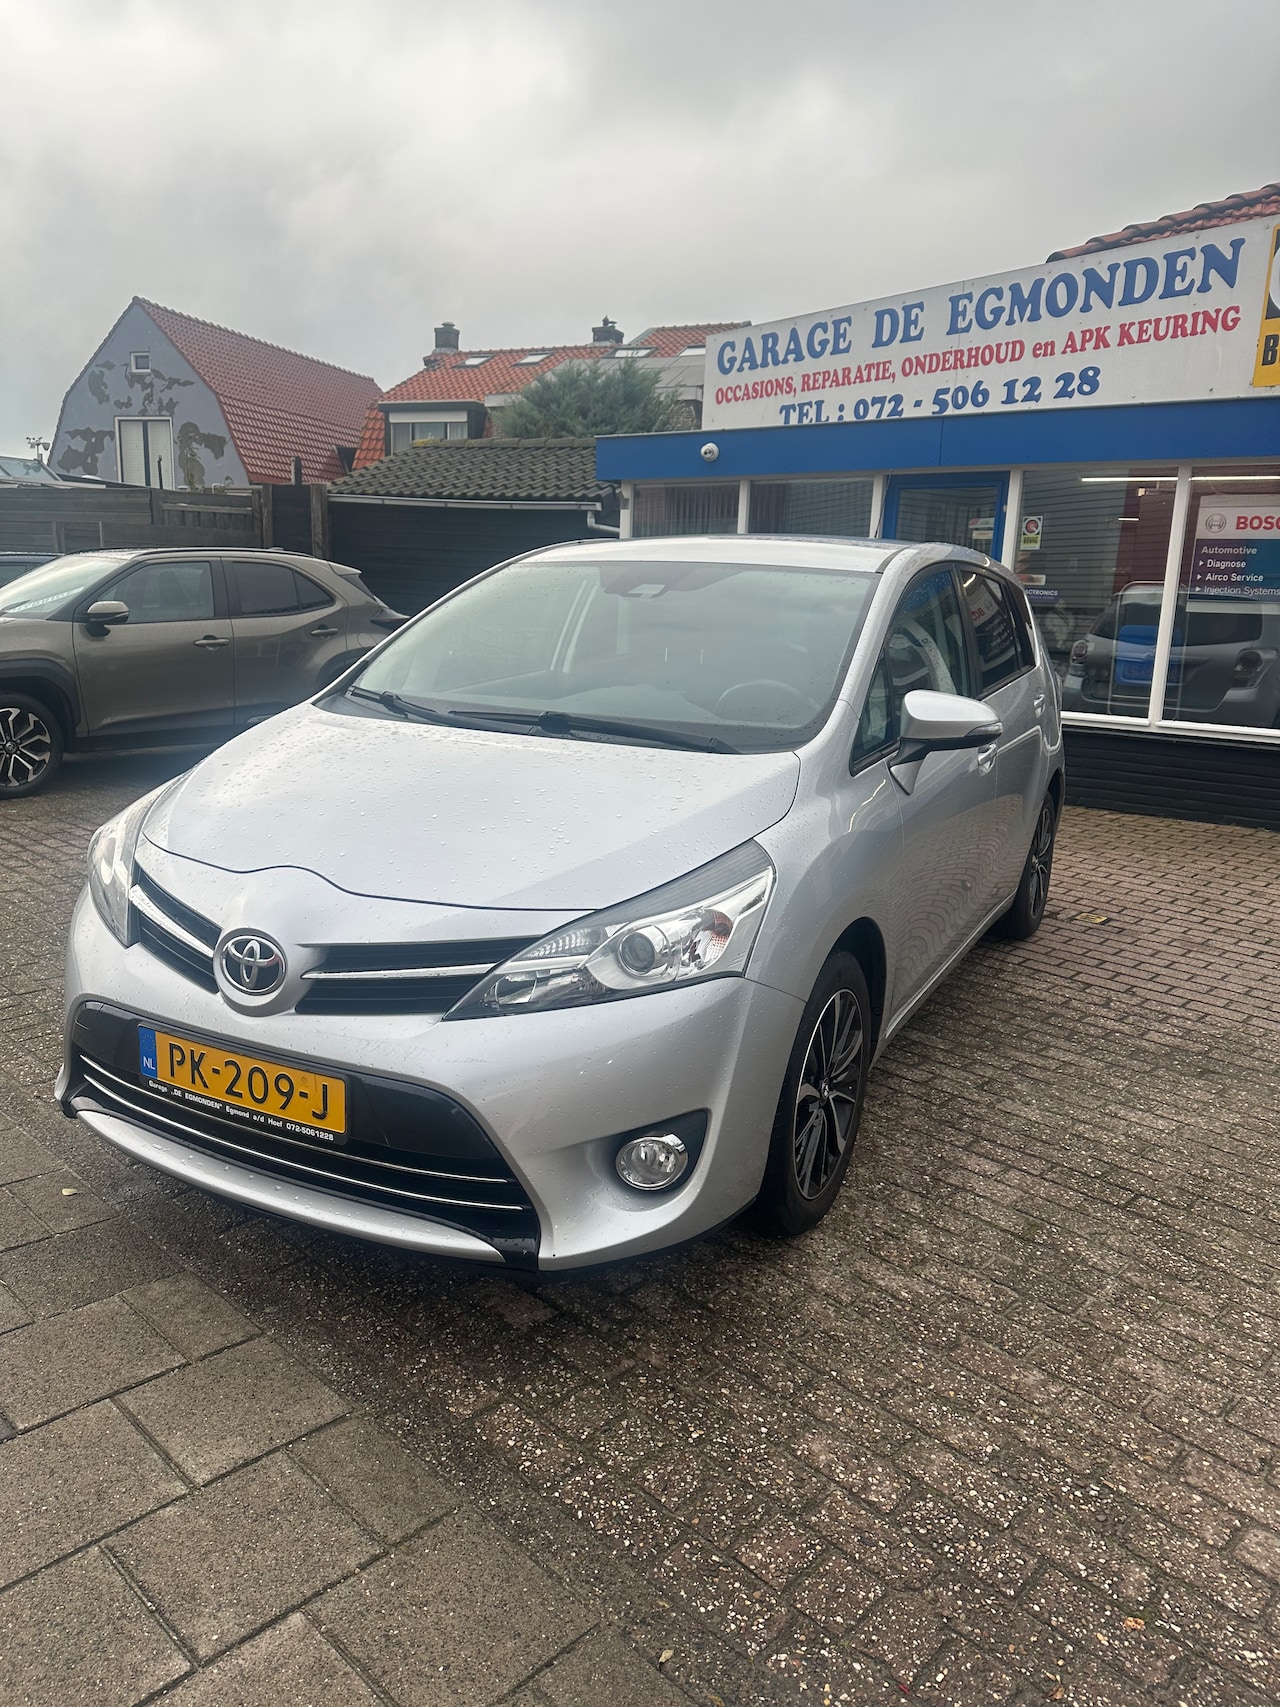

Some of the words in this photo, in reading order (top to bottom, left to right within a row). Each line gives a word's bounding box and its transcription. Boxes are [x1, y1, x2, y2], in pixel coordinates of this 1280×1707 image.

[717, 317, 853, 375] GARAGE
[871, 302, 926, 348] DE
[946, 238, 1246, 336] EGMONDEN
[715, 375, 798, 405] OCCASIONS,
[801, 360, 897, 392] REPARATIE,
[901, 339, 1025, 378] ONDERHOUD
[1032, 340, 1056, 358] en
[1062, 325, 1111, 354] APK
[1117, 305, 1242, 347] KEURING
[779, 400, 829, 426] TEL
[853, 393, 904, 420] 072
[932, 380, 990, 415] 506
[1002, 376, 1042, 405] 12
[1054, 366, 1101, 399] 28
[1201, 545, 1258, 555] Automotive
[1206, 559, 1247, 570] Diagnose
[1203, 585, 1241, 596] Injection
[1205, 572, 1229, 582] Airco
[1230, 572, 1264, 582] Service
[142, 1056, 156, 1071] NL
[168, 1041, 329, 1121] PK-209-J
[148, 1080, 168, 1093] Garage
[225, 1105, 250, 1119] Egmond
[252, 1114, 265, 1123] a/d
[267, 1117, 283, 1128] Hoef
[286, 1123, 334, 1141] 072-5061228
